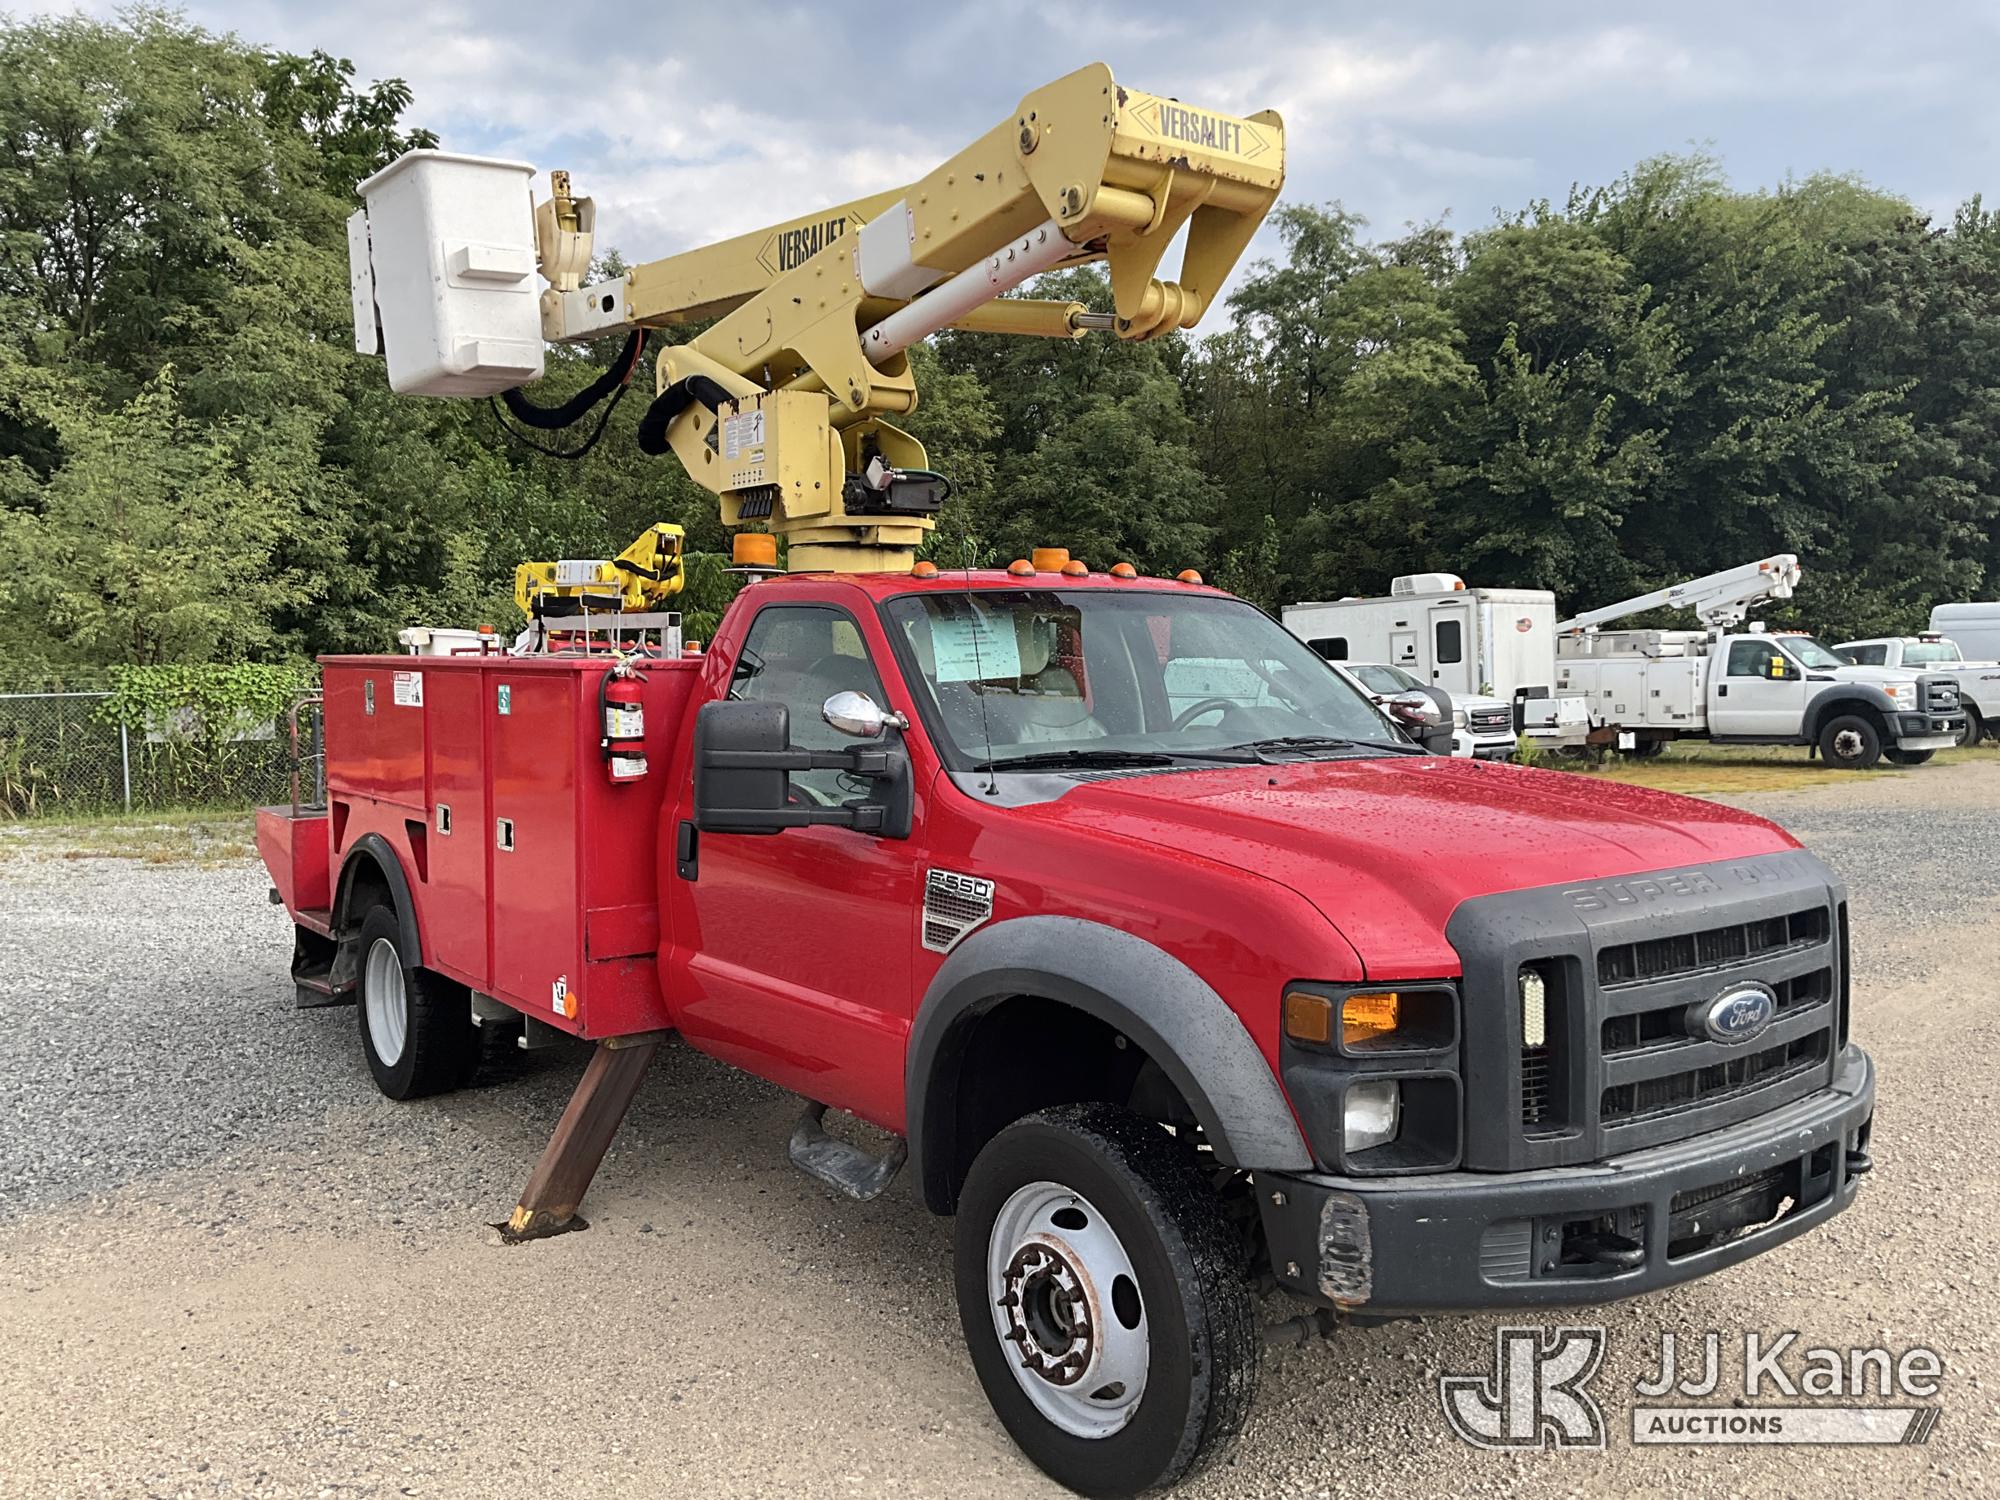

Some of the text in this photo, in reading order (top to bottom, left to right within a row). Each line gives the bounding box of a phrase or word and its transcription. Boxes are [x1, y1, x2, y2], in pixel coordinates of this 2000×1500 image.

[1160, 104, 1241, 154] VERSALIFT
[1562, 871, 1722, 911] SUPER
[1729, 999, 1763, 1028] Ford
